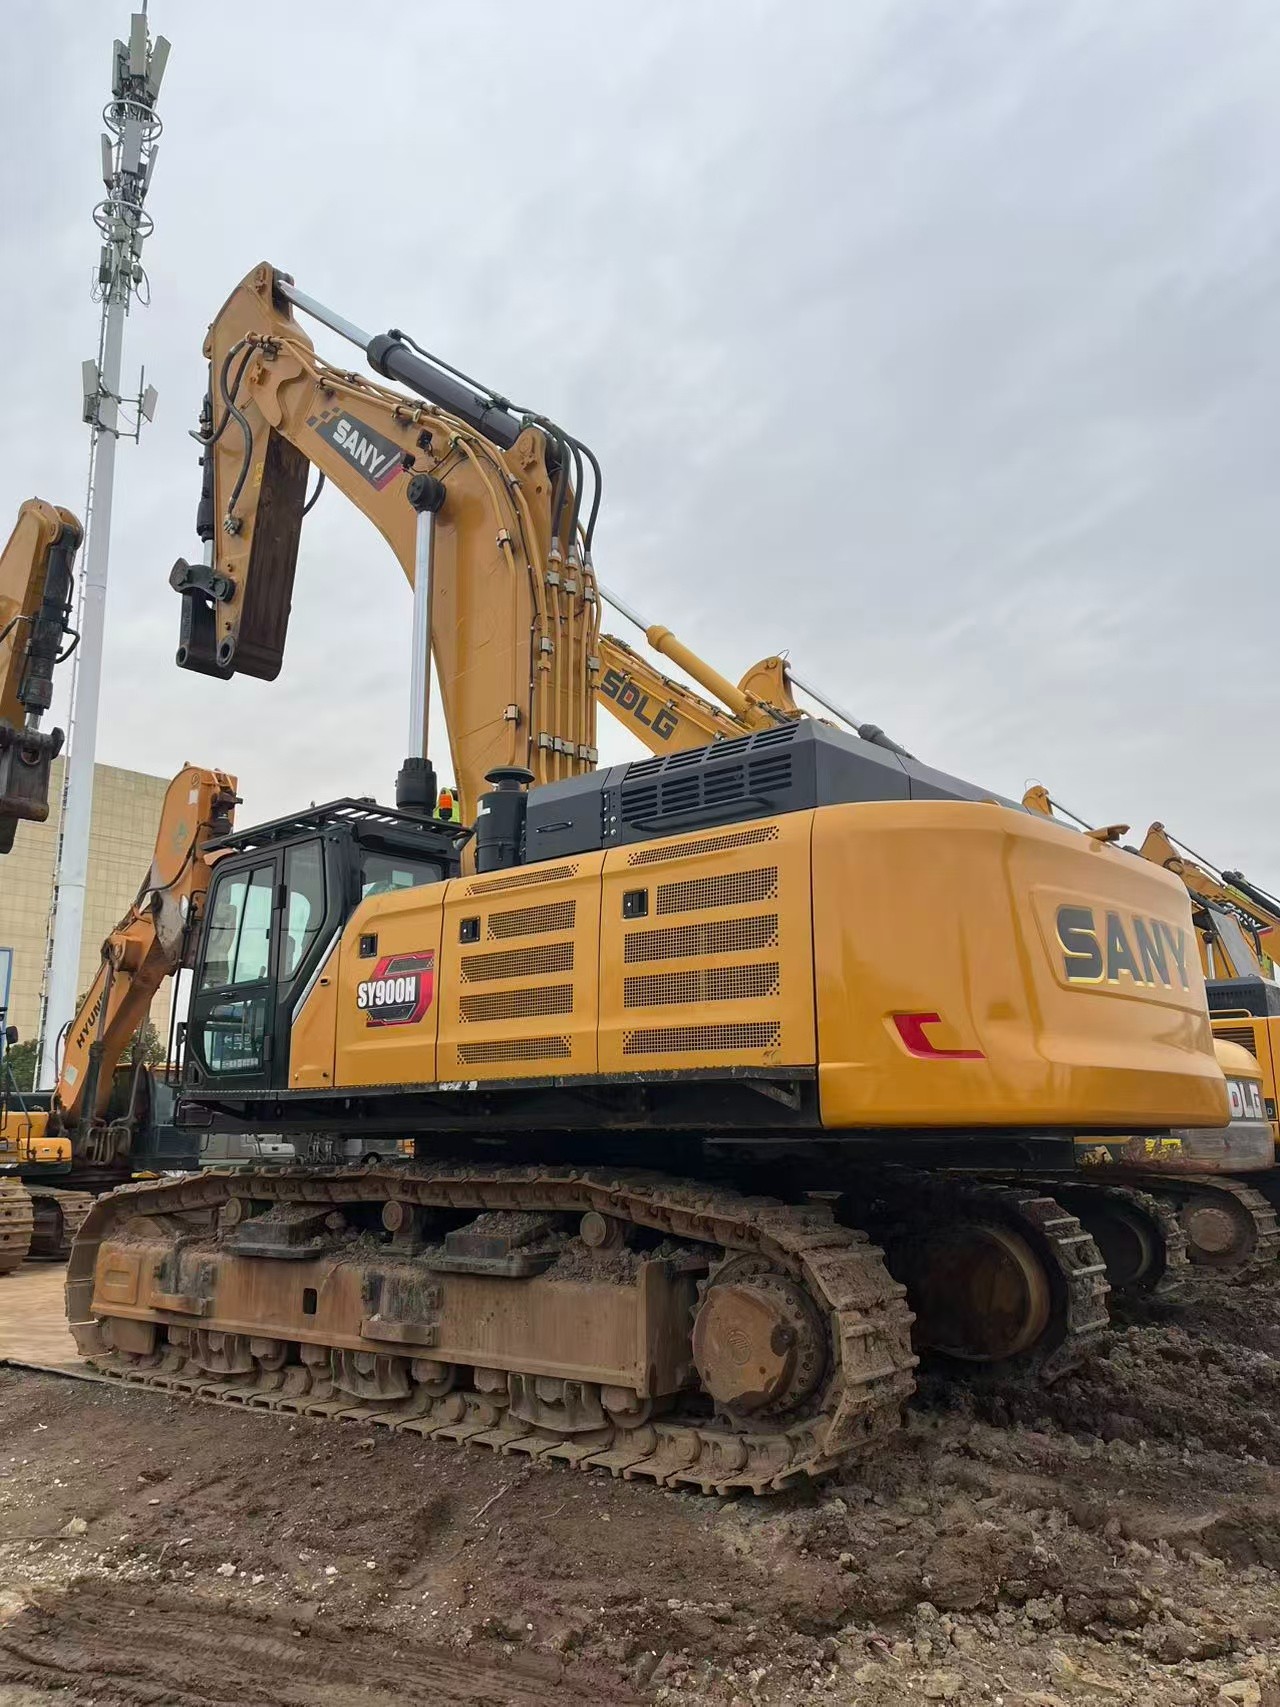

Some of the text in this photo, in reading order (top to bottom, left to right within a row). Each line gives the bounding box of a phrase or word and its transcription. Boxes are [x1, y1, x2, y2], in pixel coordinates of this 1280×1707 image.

[333, 419, 386, 474] SANY
[601, 669, 679, 741] SDLG
[1056, 905, 1189, 992] SANY
[76, 991, 104, 1049] HYUN
[357, 976, 416, 1008] SY900H
[1226, 1081, 1263, 1118] DLG
